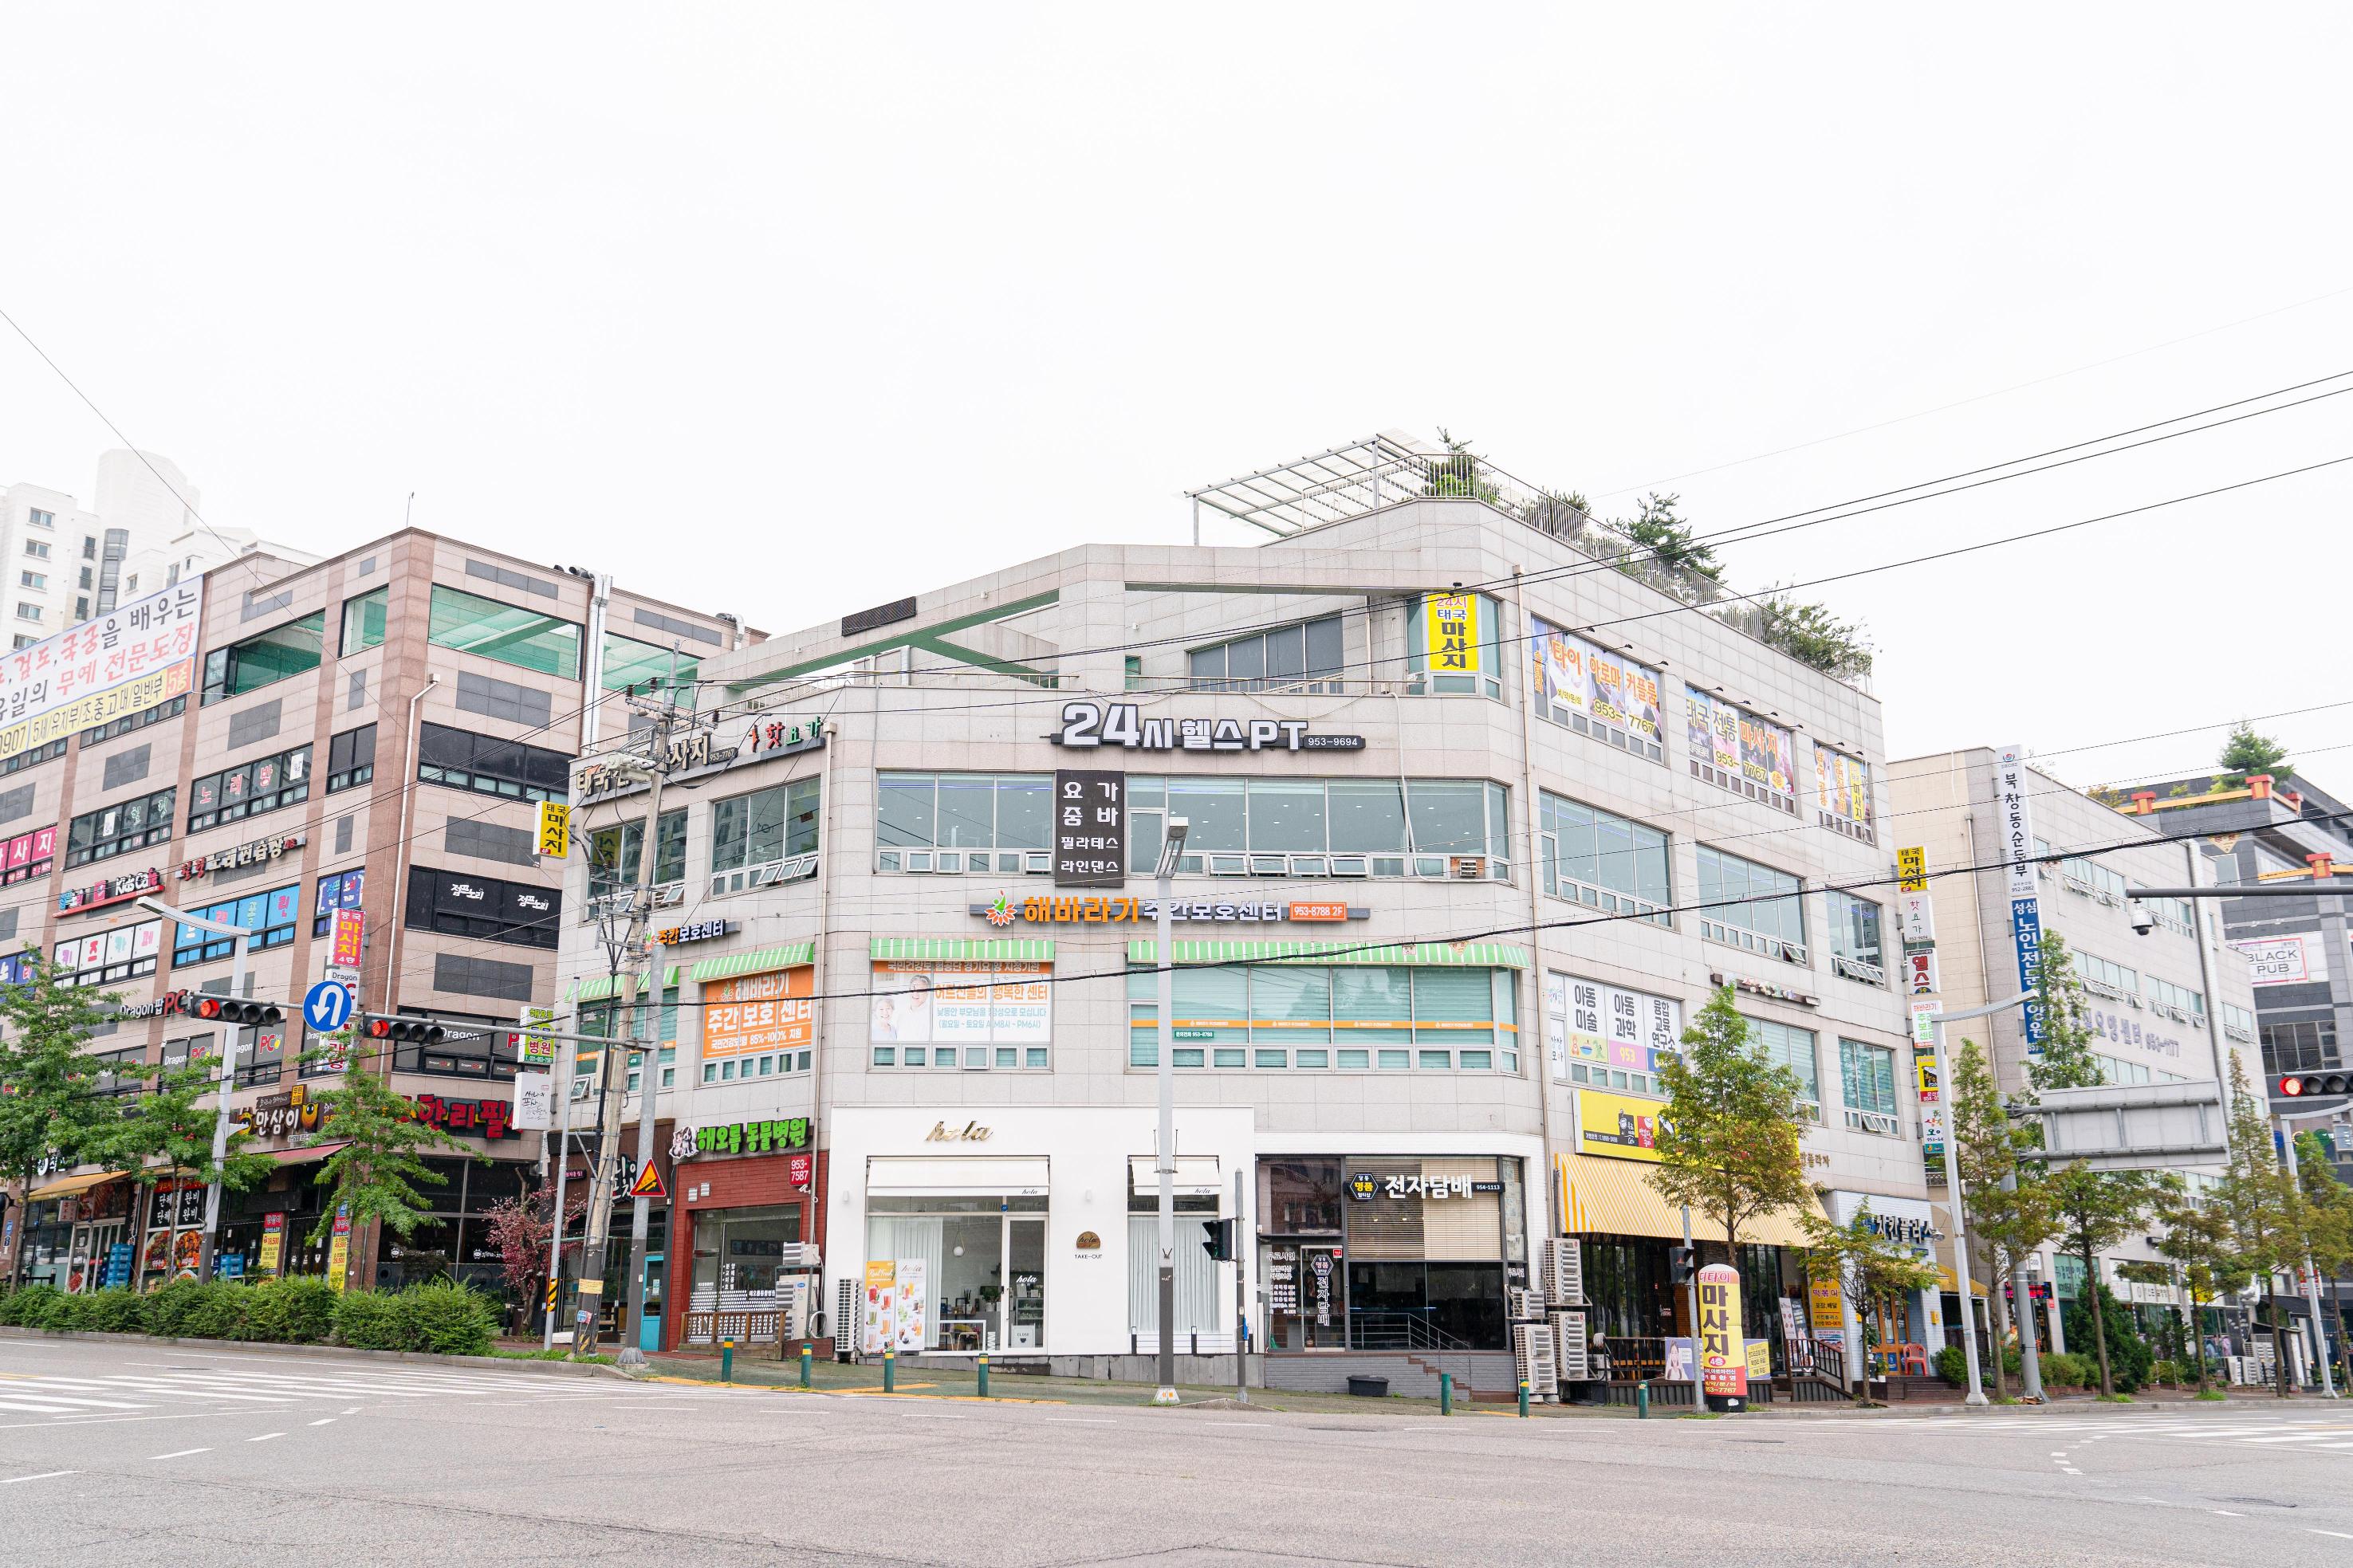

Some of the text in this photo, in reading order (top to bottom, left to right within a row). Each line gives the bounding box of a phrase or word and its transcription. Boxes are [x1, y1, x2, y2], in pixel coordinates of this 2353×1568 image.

[130, 590, 197, 631] 배우는
[1436, 596, 1467, 608] 24시
[1437, 610, 1466, 621] 태국
[1442, 622, 1466, 668] 마사지
[57, 660, 97, 695] 무예
[104, 622, 195, 682] 전문도장
[1552, 640, 1582, 676] 타이
[1589, 656, 1622, 692] 아로마
[1626, 671, 1658, 709] 커플룸
[1062, 701, 1359, 752] 24시 헬스 PT 953-9694
[1629, 714, 1656, 735] 7767
[1686, 697, 1780, 763] 태국 전통 마사지
[709, 749, 734, 762] 953-7767
[1743, 760, 1767, 782] 7767
[1063, 782, 1119, 802] 요가
[546, 804, 567, 815] 태국
[1063, 807, 1119, 827] 줌바
[545, 814, 565, 853] 마사지
[0, 831, 53, 867] 사지
[1061, 837, 1119, 851] 필라테스
[1901, 847, 1920, 856] 태국
[1061, 860, 1119, 874] 라인댄스
[451, 883, 485, 900] 점프노리
[517, 894, 549, 910] 점프노리
[1023, 895, 1139, 924] 해바라기
[1293, 906, 1344, 917] 953-8788 2F
[2013, 902, 2037, 915] 성심
[341, 911, 361, 922] 중국
[337, 921, 361, 957] 마사지
[657, 919, 725, 946] 주간보호센터
[332, 972, 357, 981] Dragon
[2257, 964, 2290, 975] PUB
[735, 972, 790, 1001] 해바라기
[993, 984, 1025, 1000] 행복한
[1027, 984, 1048, 1000] 센터
[1574, 984, 1596, 1009] 아동
[163, 988, 188, 1016] PC
[1019, 1007, 1046, 1017] 모십니다
[1614, 993, 1635, 1017] 아동
[1653, 999, 1670, 1017] 융합
[1914, 1002, 1938, 1012] 해바라기
[707, 996, 813, 1034] 주간 보호 센터
[1576, 1008, 1598, 1032] 미술
[1655, 1016, 1670, 1034] 교육
[790, 1028, 802, 1039] 지원
[1615, 1017, 1636, 1040] 과학
[236, 1034, 275, 1055] agon PC
[529, 1041, 551, 1055] 병원
[1651, 1031, 1676, 1052] 연구소
[164, 1055, 187, 1066] Dragon
[255, 1107, 300, 1137] 만삼이
[924, 1118, 995, 1142] hola
[697, 1117, 809, 1153] 해오름 동물병원
[790, 1159, 808, 1170] 953-
[790, 1170, 809, 1182] 7587
[1021, 1187, 1038, 1196] hola
[1194, 1186, 1211, 1195] hola
[1385, 1173, 1474, 1200] 전자담배
[1876, 1214, 1934, 1244] 치킨플러스
[1016, 1275, 1038, 1283] hola
[1316, 1275, 1330, 1326] 전자담배
[1702, 1284, 1729, 1356] 마사지
